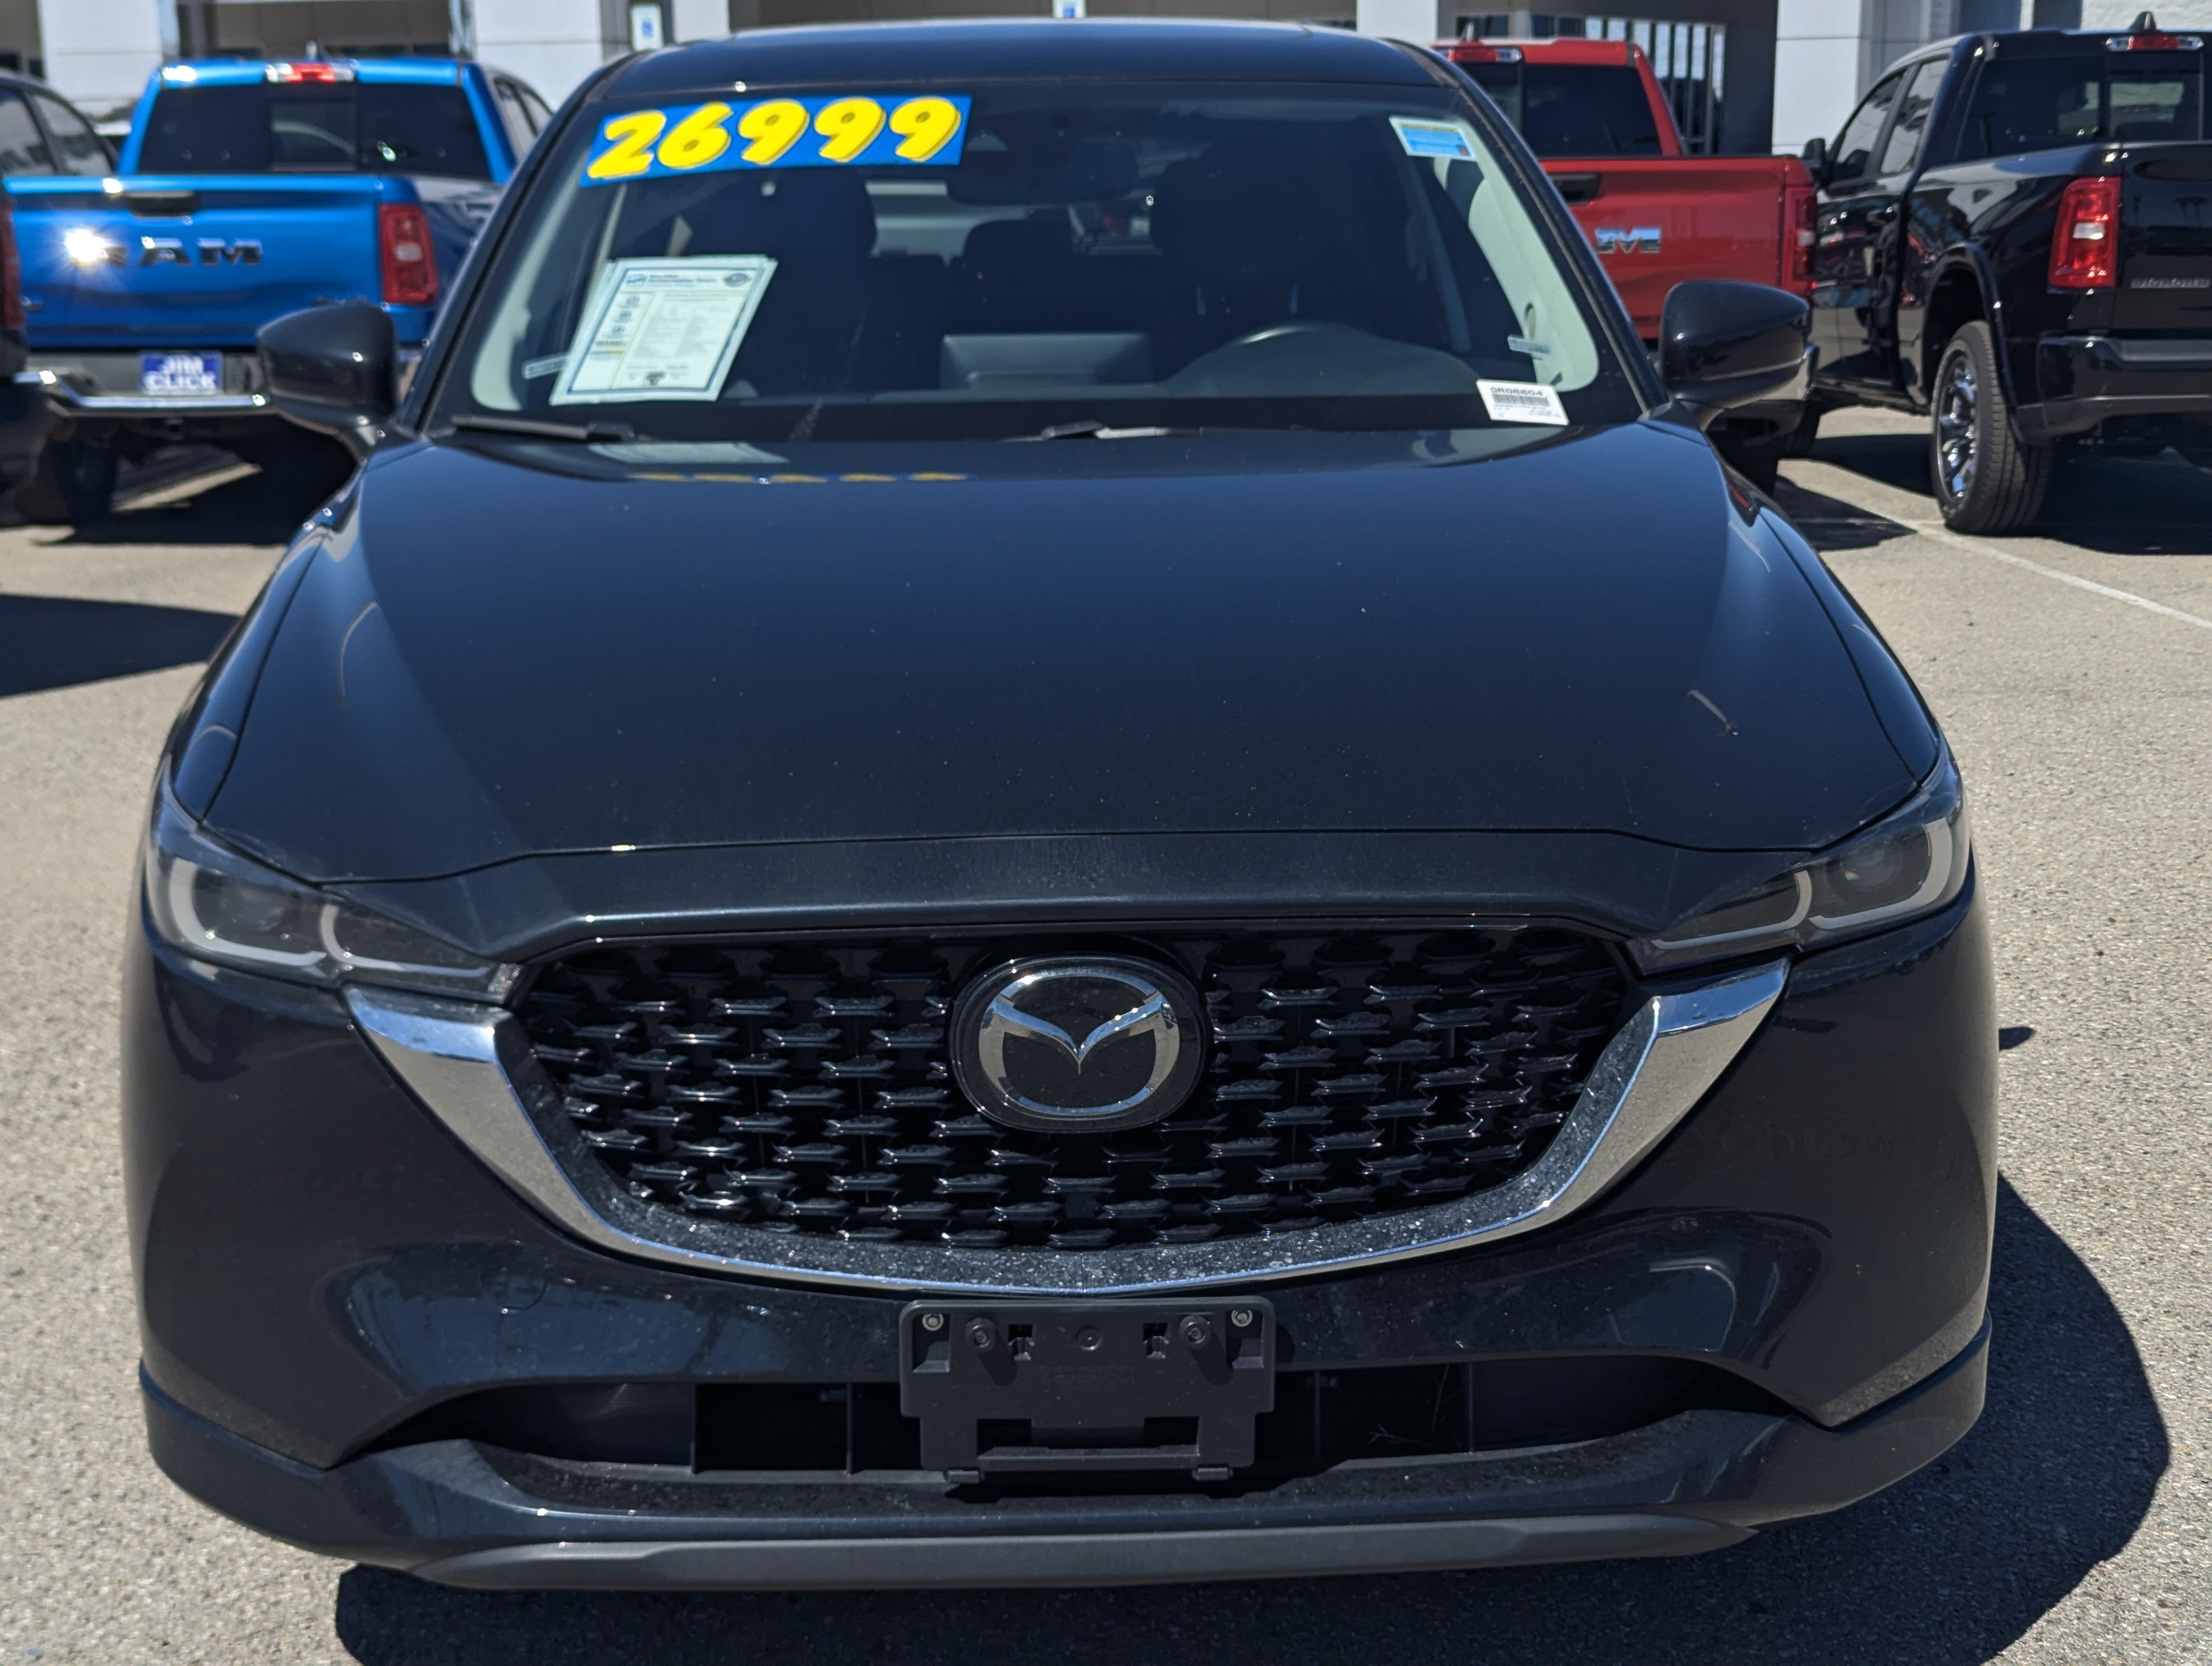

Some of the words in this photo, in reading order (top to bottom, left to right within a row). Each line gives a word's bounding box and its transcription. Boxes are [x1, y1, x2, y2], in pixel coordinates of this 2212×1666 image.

[588, 97, 961, 178] 26999
[160, 356, 204, 373] JIM
[144, 371, 216, 393] CLICK
